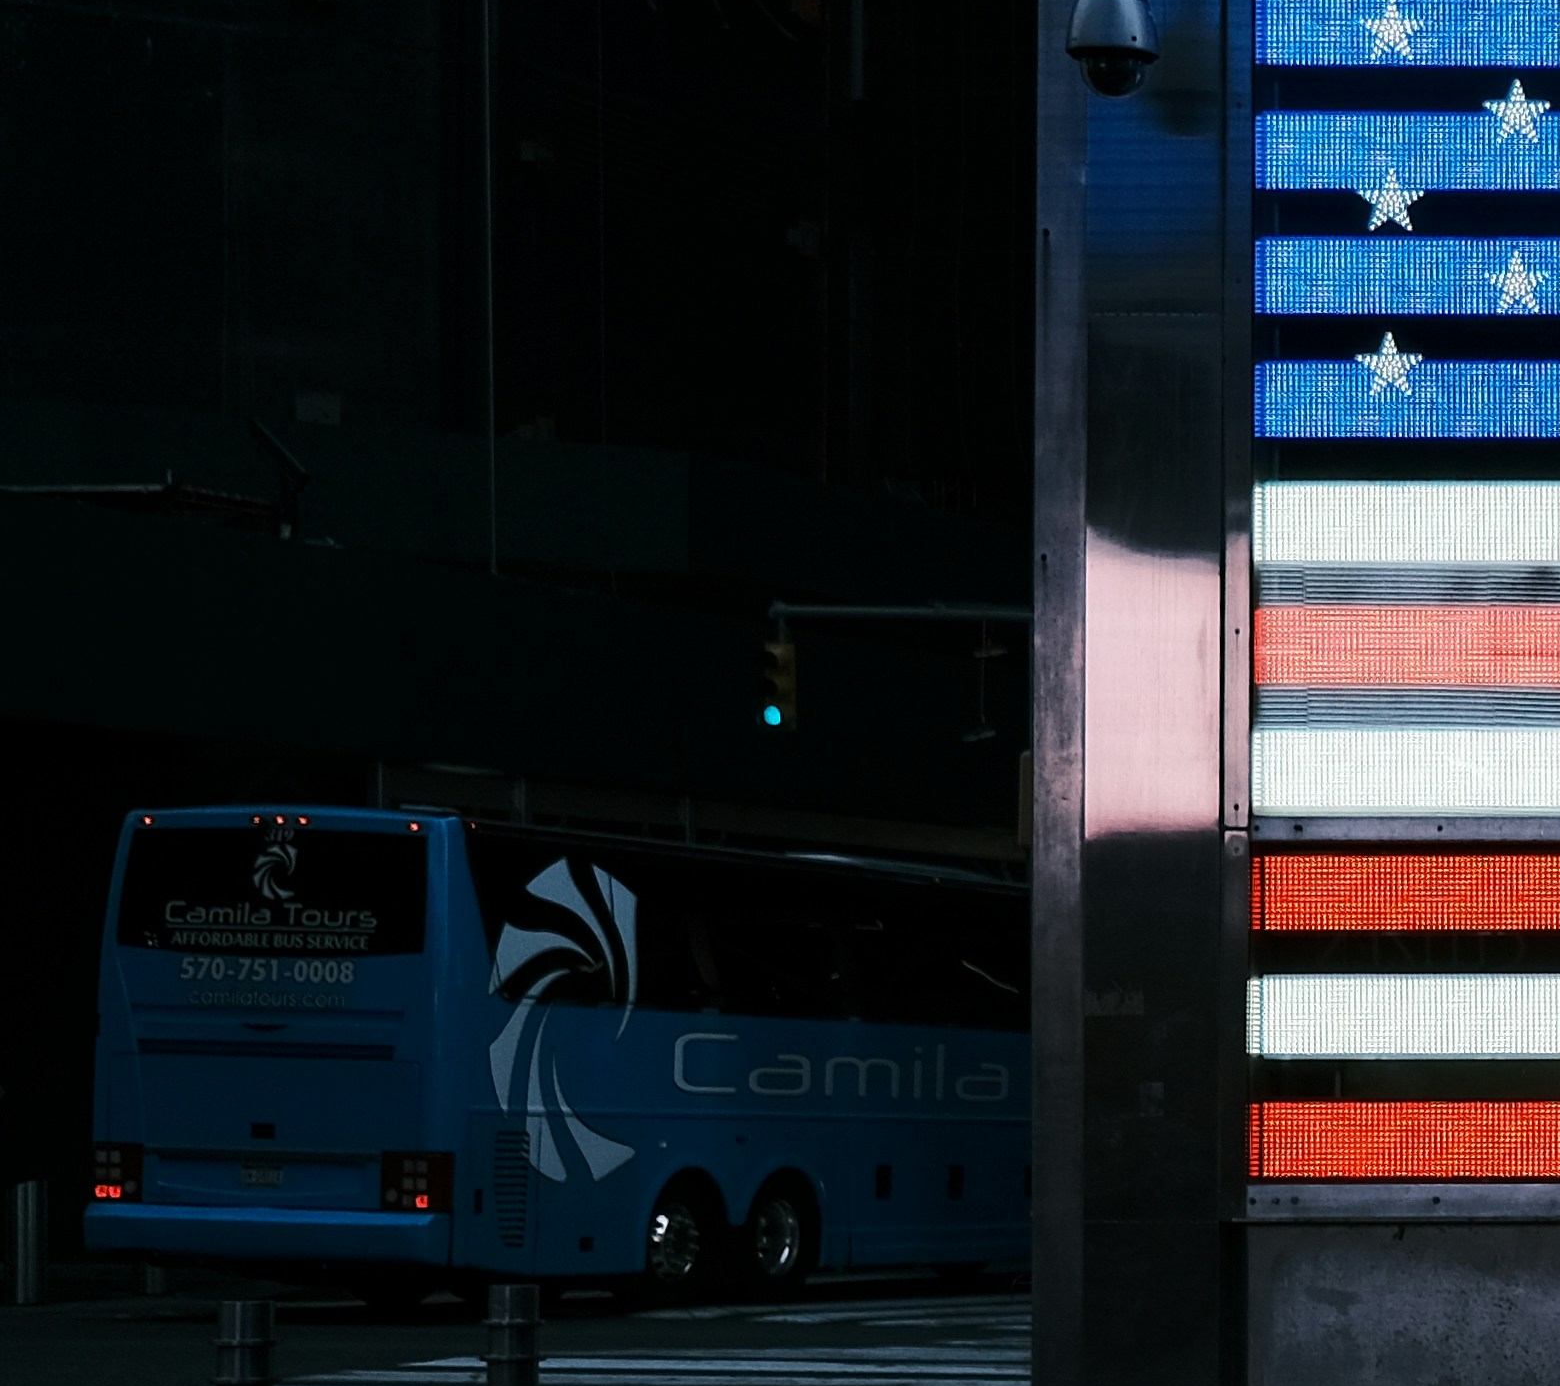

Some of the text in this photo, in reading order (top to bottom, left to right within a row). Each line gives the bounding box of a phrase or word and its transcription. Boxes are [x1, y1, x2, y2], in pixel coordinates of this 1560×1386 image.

[164, 899, 378, 928] Camila Tours
[169, 930, 369, 951] AFFORDABLE BUS SERVICE
[180, 956, 355, 984] 570-751-0008
[187, 987, 346, 1009] camilatours.com
[673, 1032, 1009, 1102] Camila
